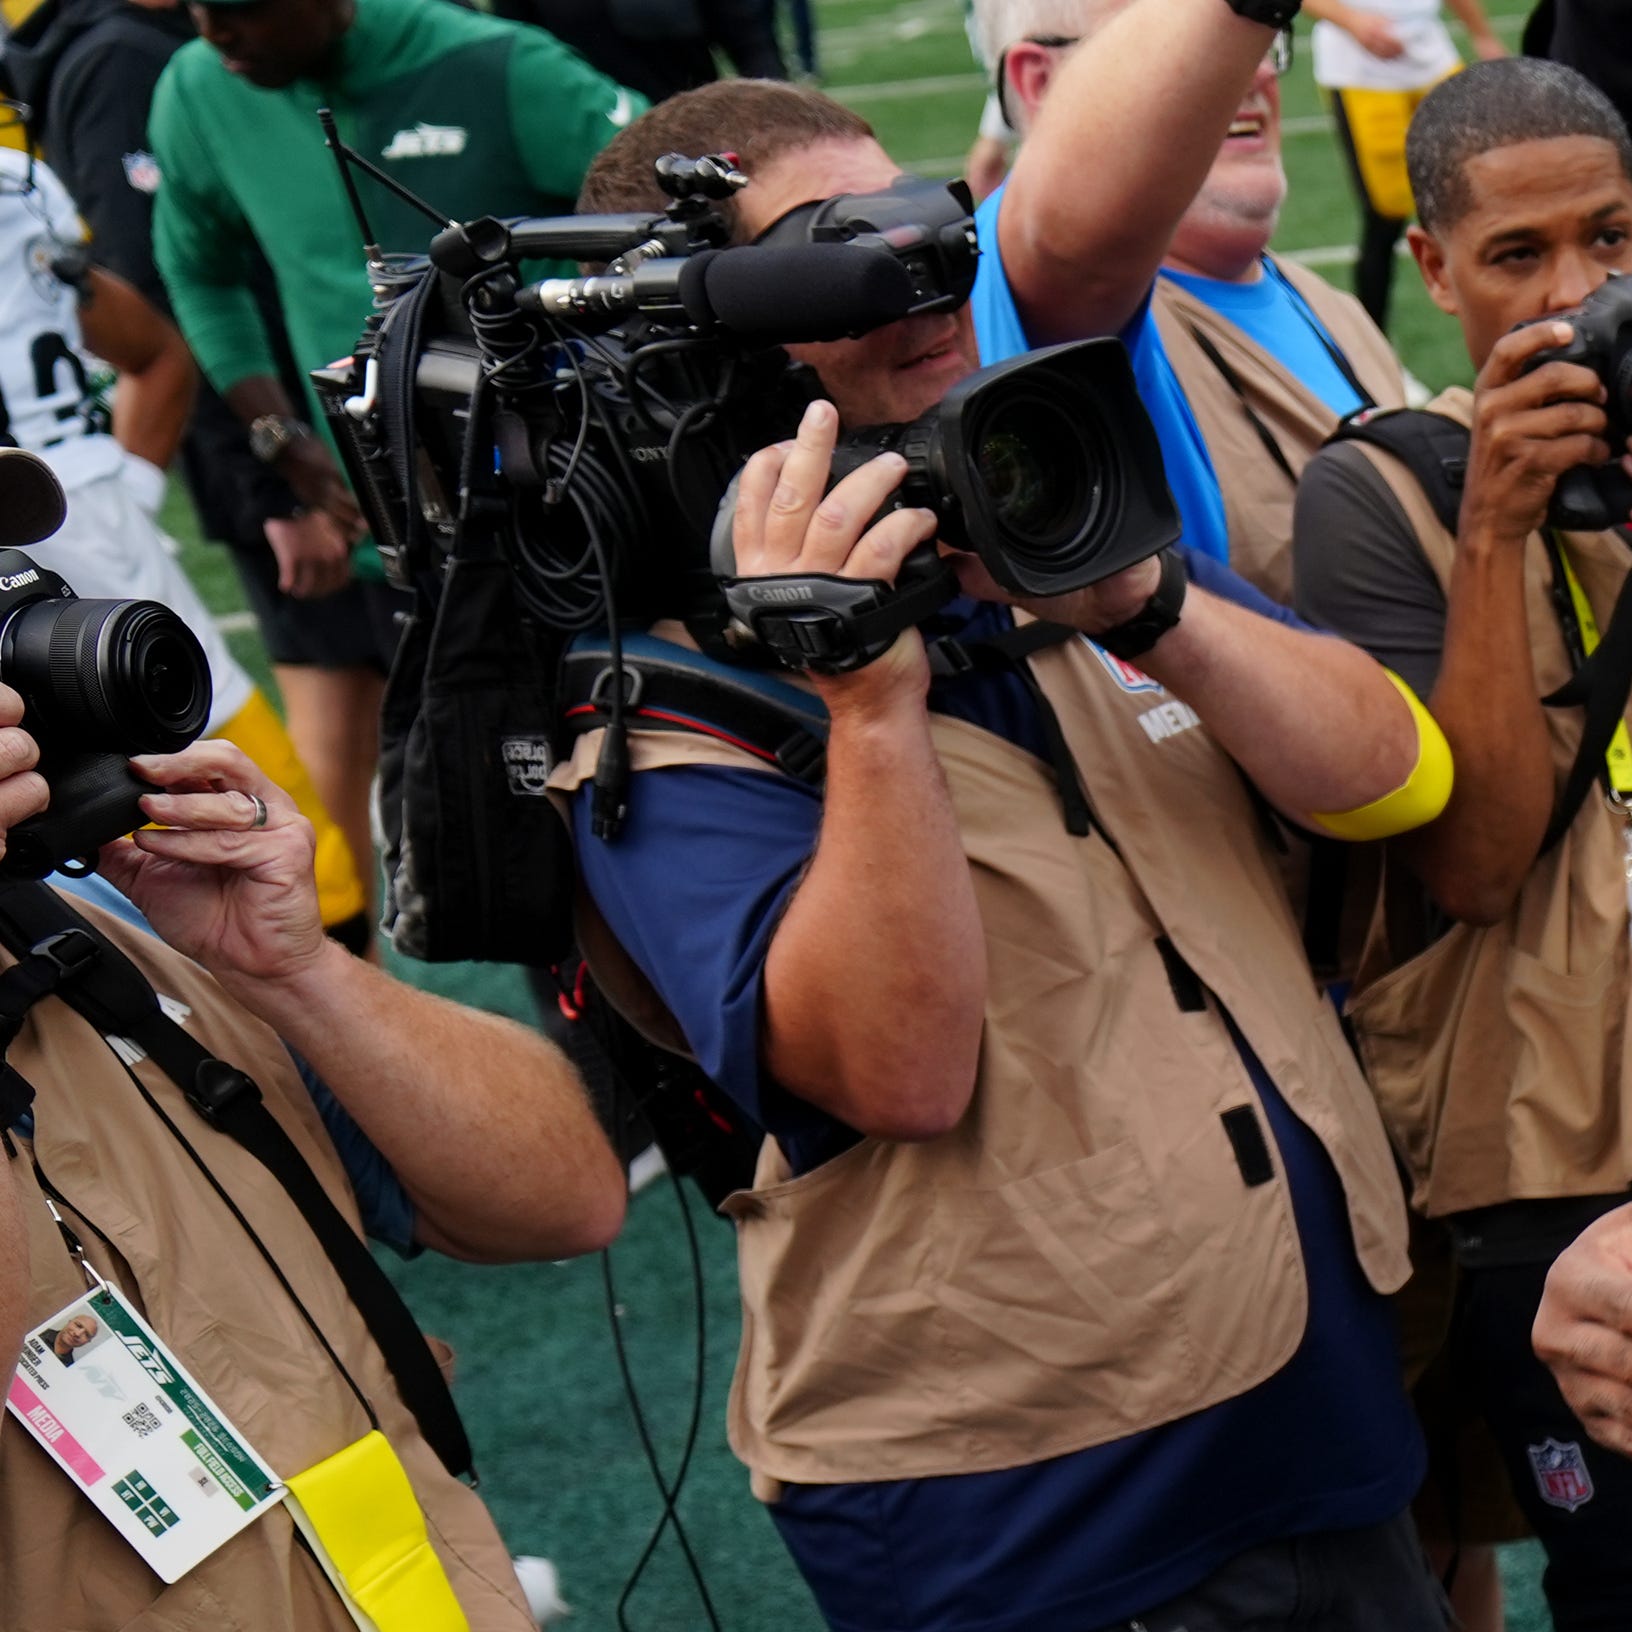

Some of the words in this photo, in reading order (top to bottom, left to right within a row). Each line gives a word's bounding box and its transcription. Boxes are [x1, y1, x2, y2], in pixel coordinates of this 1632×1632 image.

[0, 568, 40, 592] Canon
[747, 585, 815, 603] Canon
[113, 1330, 176, 1387] JETS
[25, 1404, 65, 1443] MEDIA
